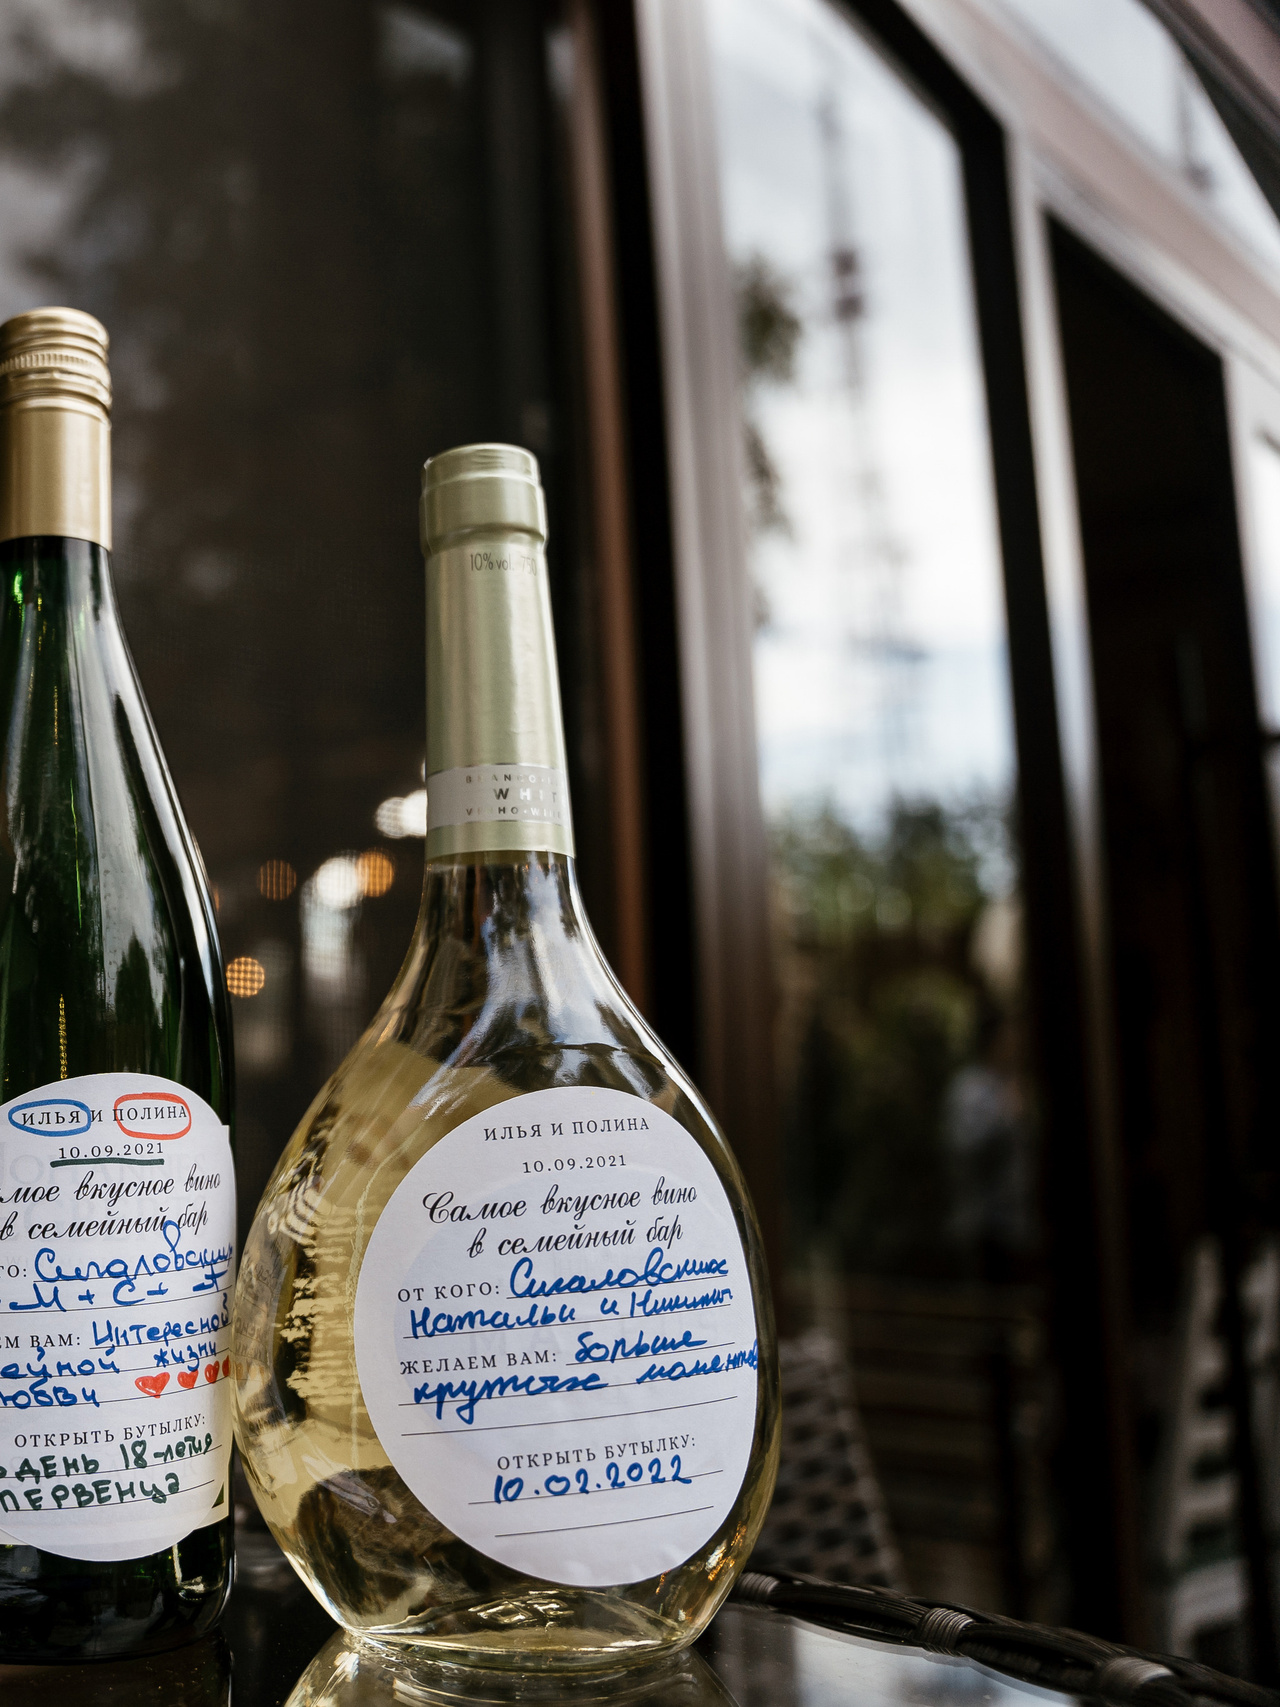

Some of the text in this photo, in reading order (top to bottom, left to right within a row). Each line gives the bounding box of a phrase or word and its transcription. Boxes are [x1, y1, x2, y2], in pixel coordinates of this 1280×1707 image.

[470, 552, 493, 571] 10%
[493, 787, 558, 803] WHIT
[22, 1105, 188, 1126] ИЛЬЯ И ПОЛИНА
[483, 1116, 650, 1142] ИЛЬЯ И ПОЛИНА
[58, 1142, 164, 1160] 10.09.2021
[522, 1154, 627, 1175] 10.09.2021
[73, 1170, 175, 1209] вкусное
[184, 1163, 221, 1193] вино
[422, 1175, 698, 1224] Самое вкусное вино
[27, 1206, 170, 1241] семейный
[176, 1201, 209, 1236] бар
[466, 1214, 684, 1259] в семейный бар
[397, 1281, 501, 1303] ОТ КОГО:
[599, 1296, 620, 1316] и
[30, 1333, 82, 1349] ВАМ:
[399, 1350, 557, 1376] ЖЕЛАЕМ ВАМ:
[14, 1413, 206, 1448] ОТКРЫТЬ БУТЫЛКУ:
[496, 1433, 696, 1470] ОТКРЫТЬ БУТЫЛКУ:
[493, 1453, 693, 1504] 10.02.2022
